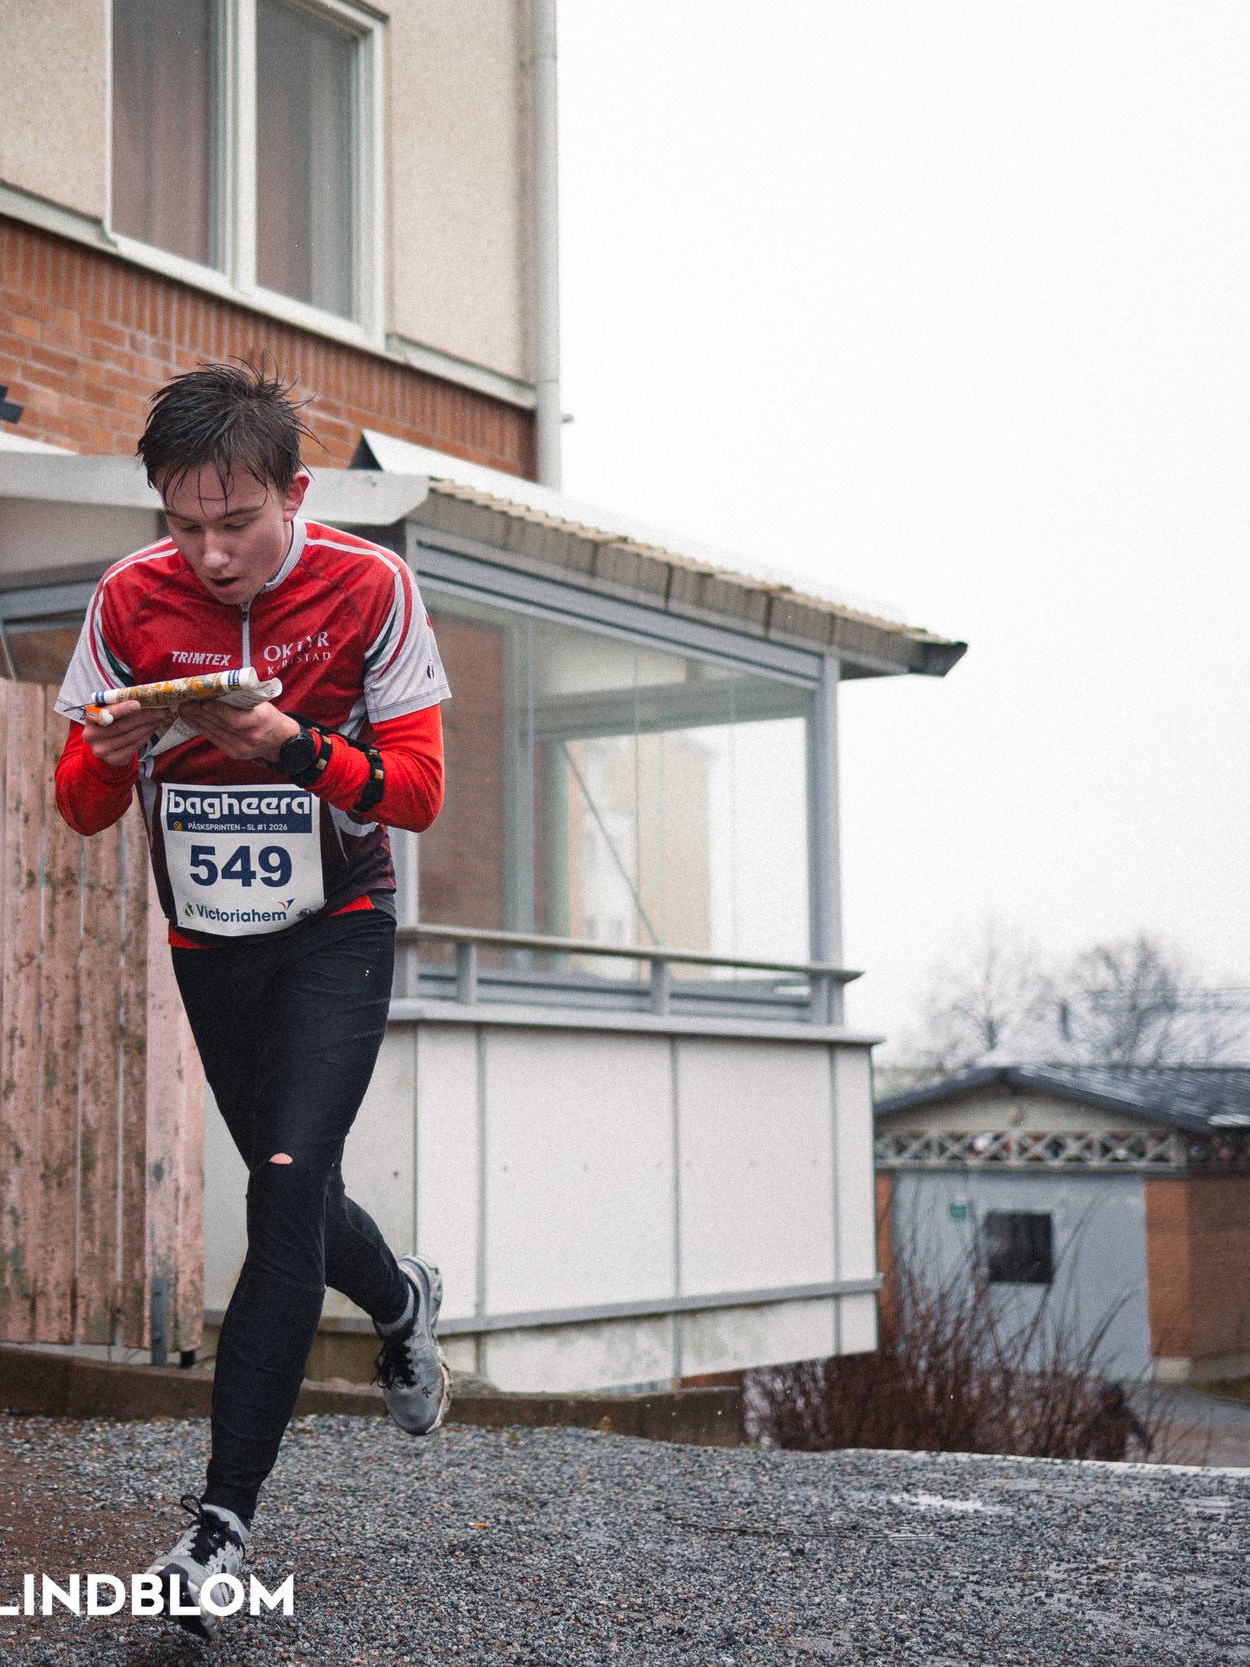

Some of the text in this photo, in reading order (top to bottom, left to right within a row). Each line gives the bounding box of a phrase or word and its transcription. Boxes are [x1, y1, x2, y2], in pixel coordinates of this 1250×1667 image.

[172, 651, 231, 667] TRIMTEX
[263, 643, 294, 661] OK
[168, 791, 310, 819] bagheera
[188, 821, 240, 831] PÅSKSPRINTEN
[189, 844, 292, 888] 549
[196, 903, 287, 923] Victoriahem
